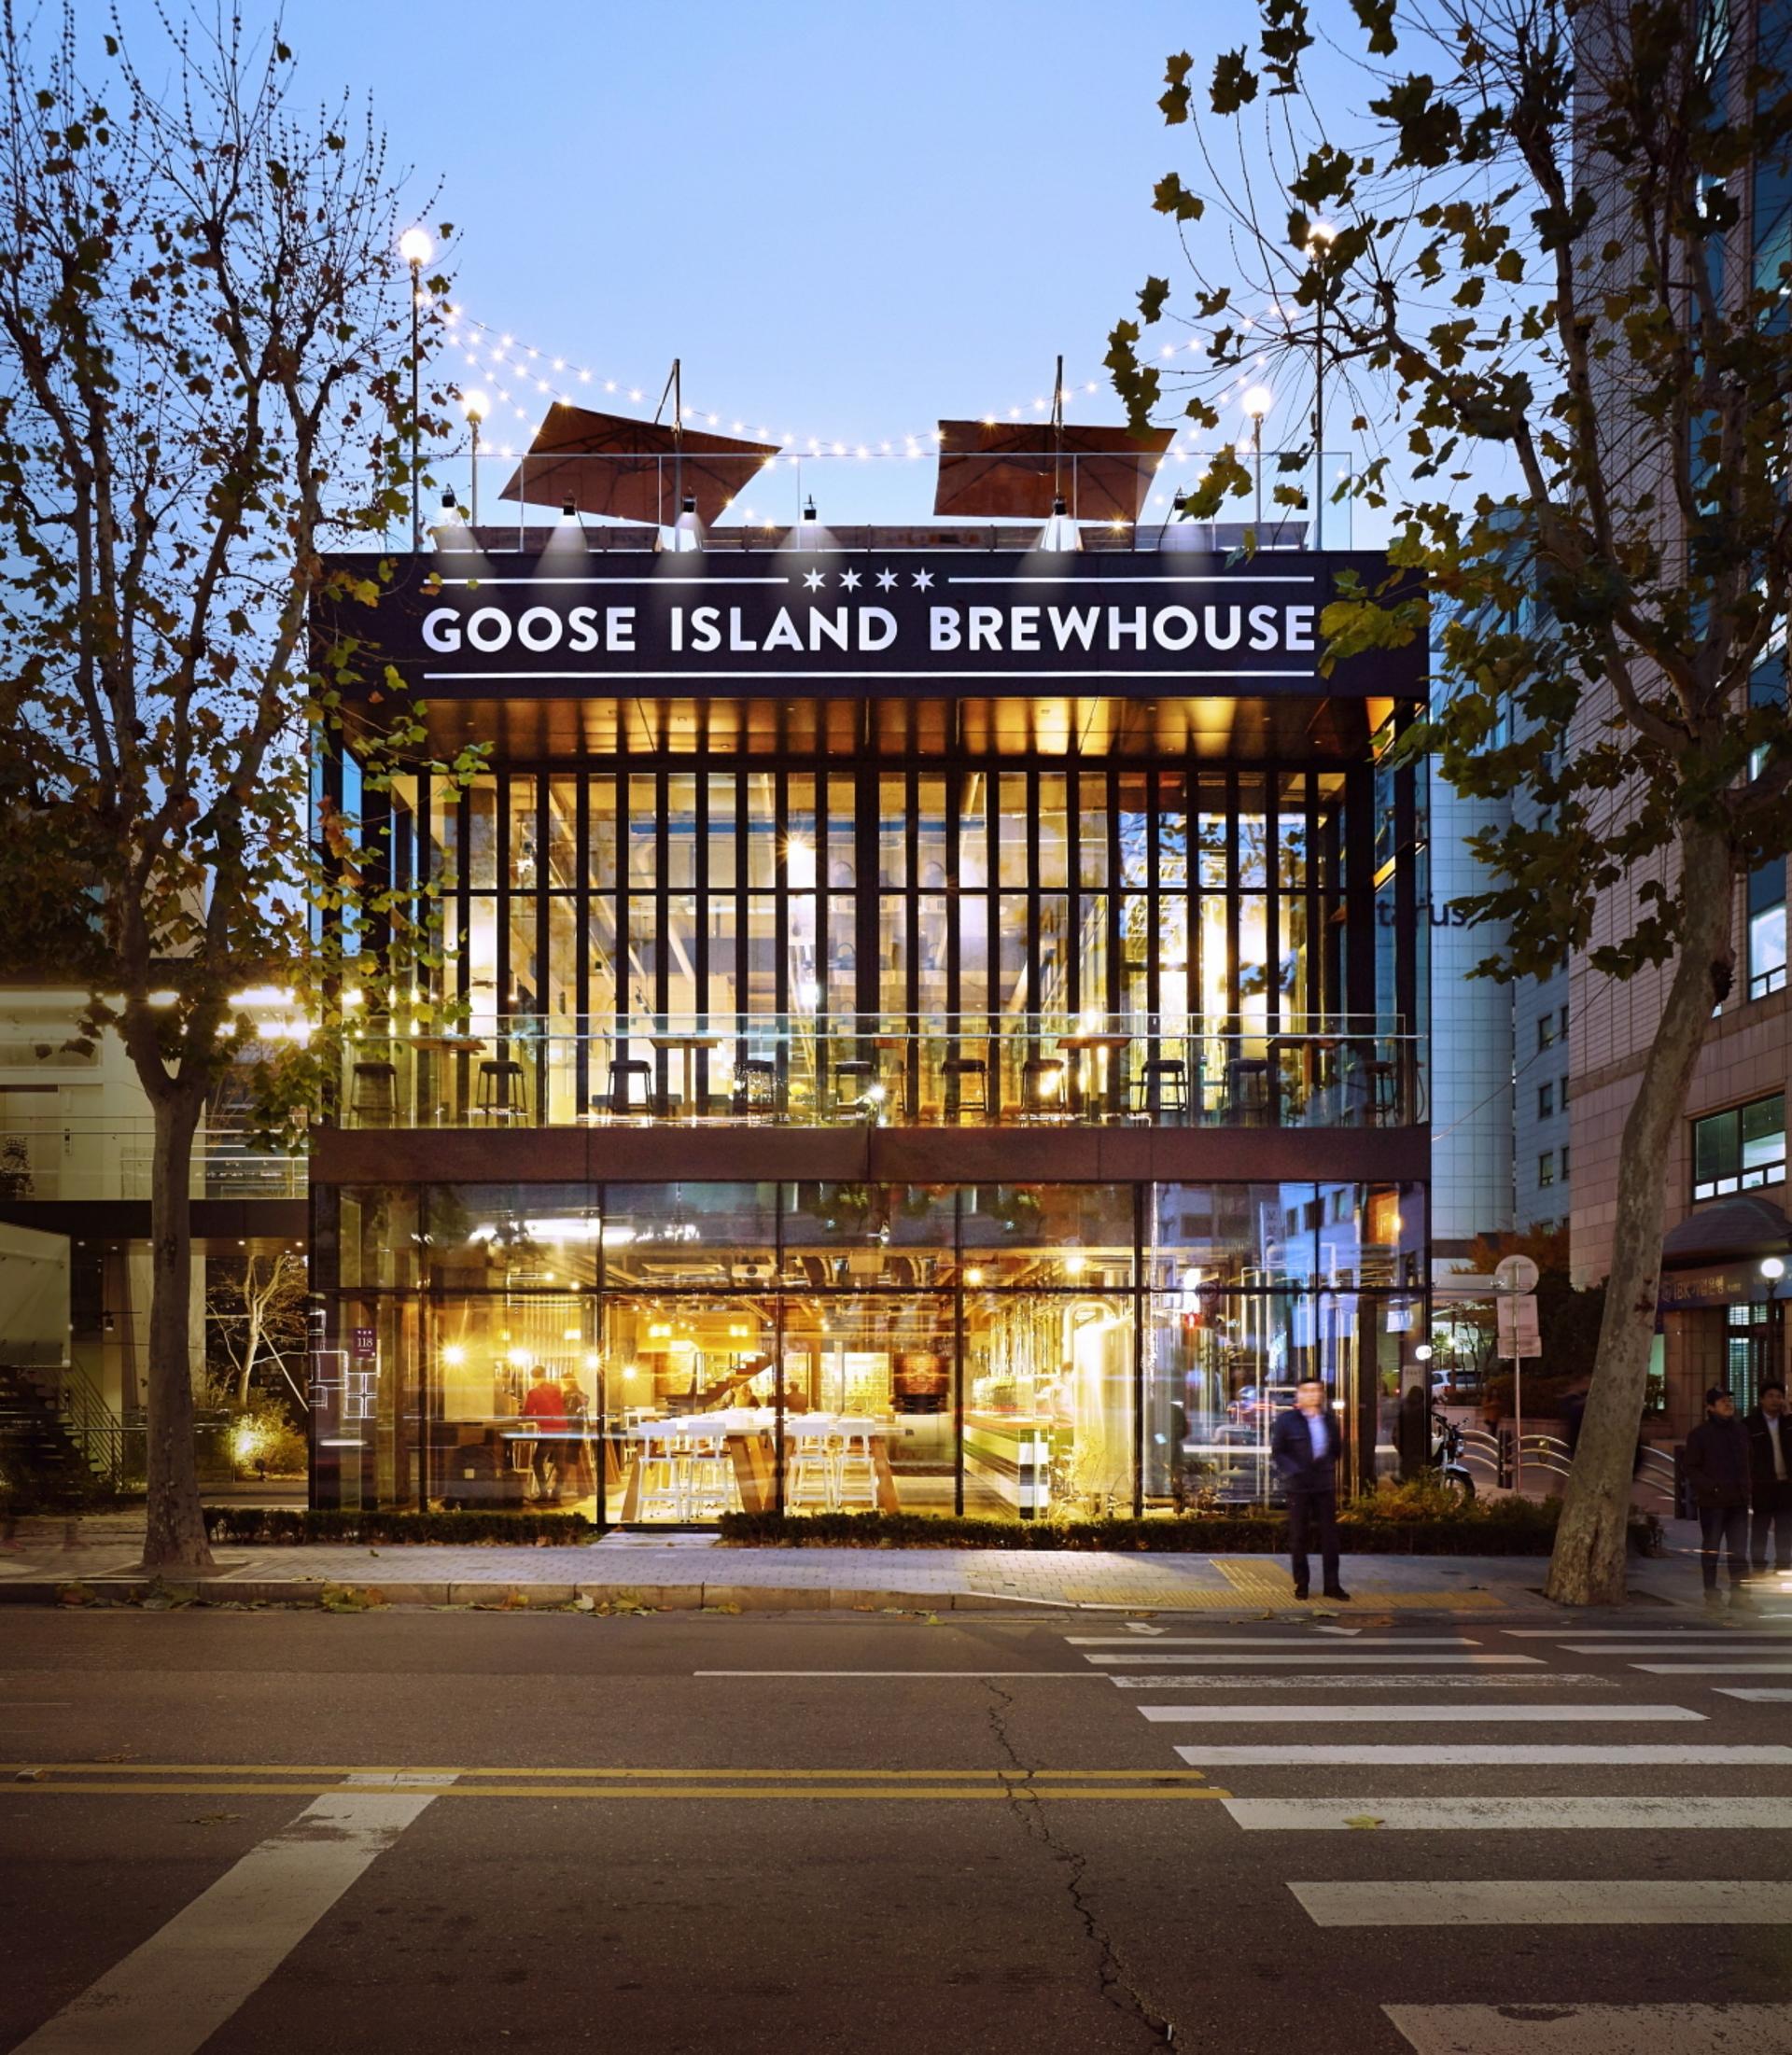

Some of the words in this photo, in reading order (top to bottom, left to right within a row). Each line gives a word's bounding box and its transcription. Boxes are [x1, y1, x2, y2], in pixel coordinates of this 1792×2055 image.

[422, 607, 637, 652] GOOSE
[671, 606, 898, 652] ISLAND
[930, 605, 1315, 651] BREWHOUSE
[357, 1337, 373, 1348] 118
